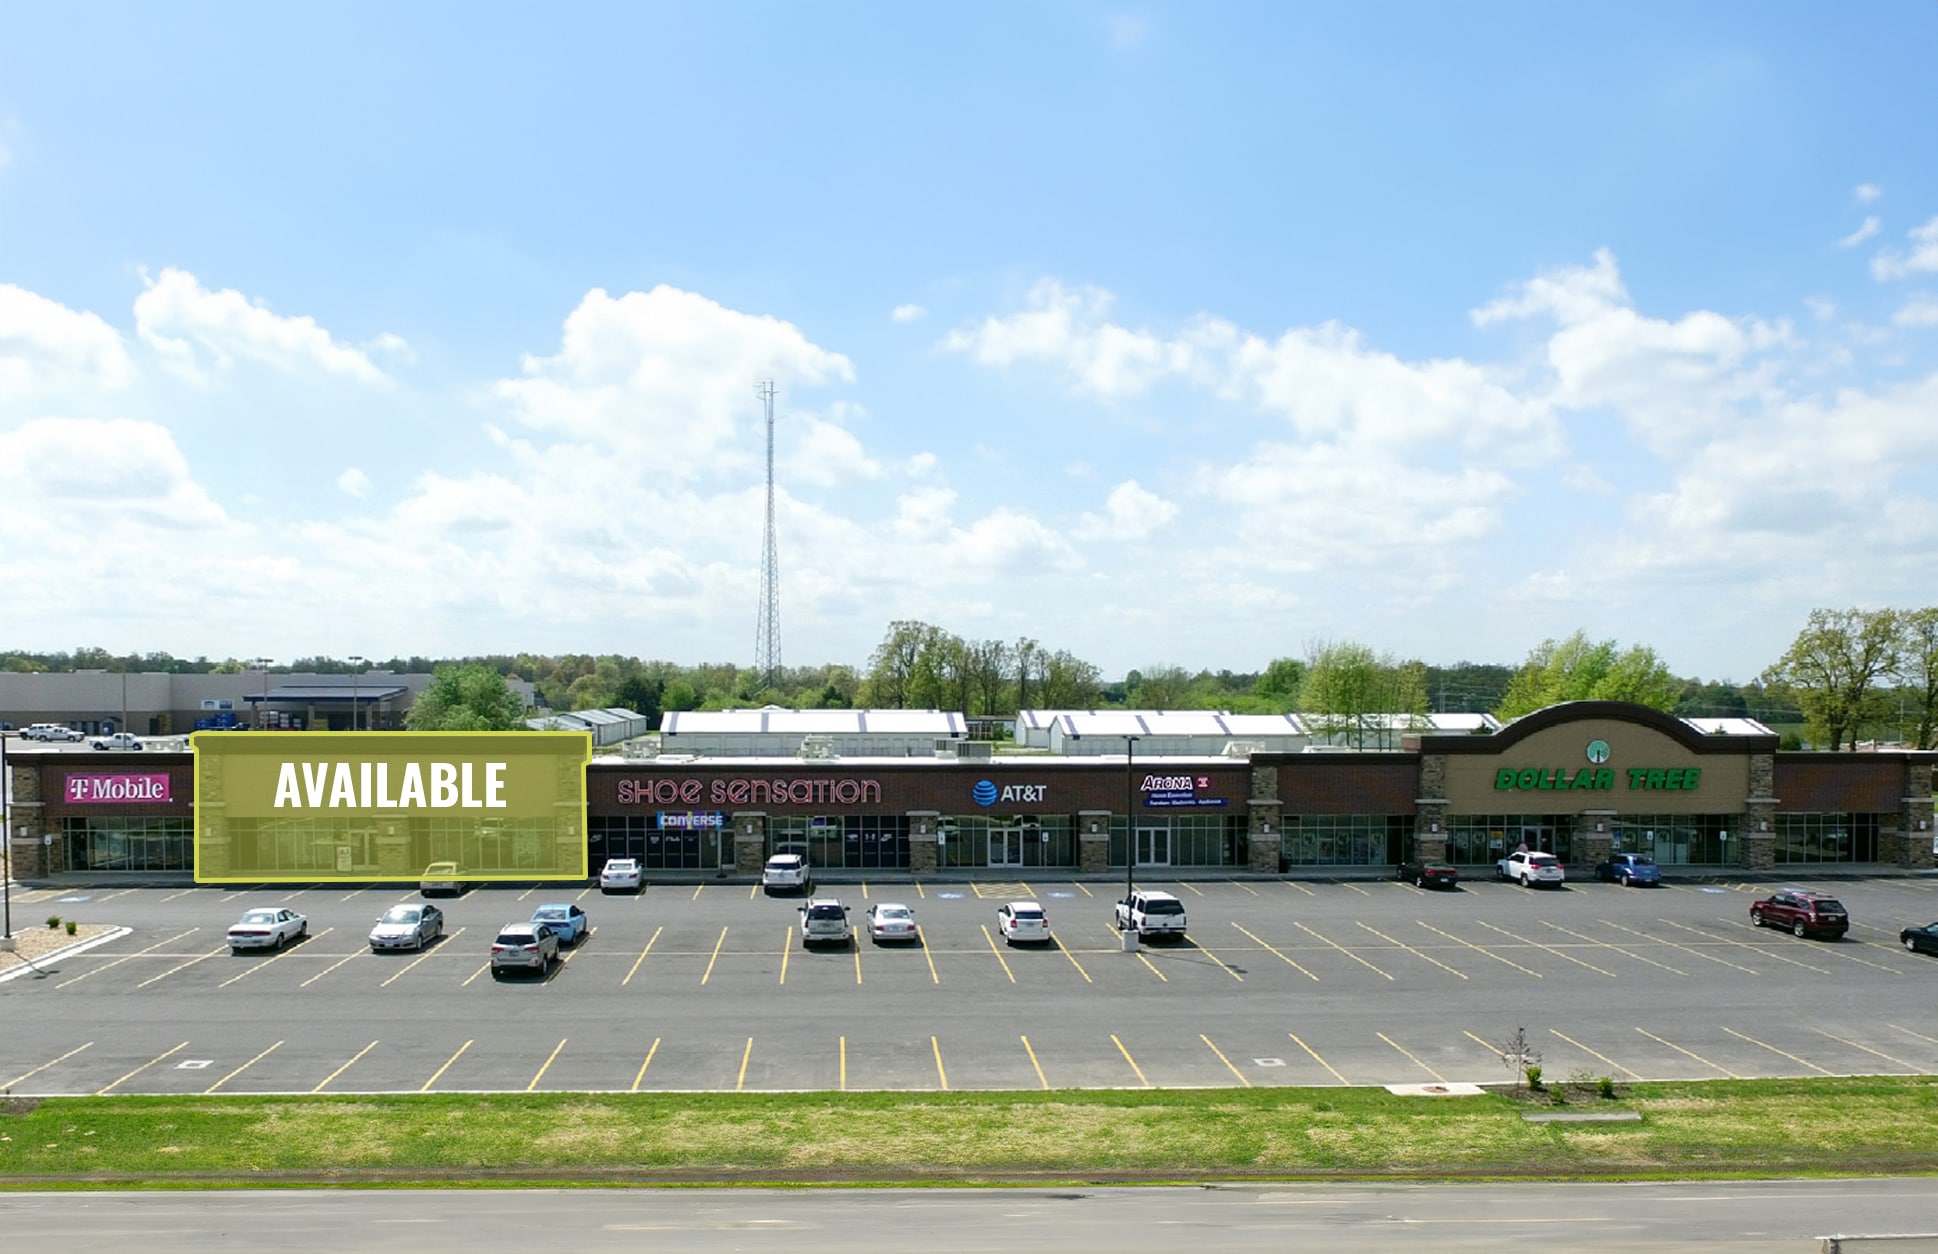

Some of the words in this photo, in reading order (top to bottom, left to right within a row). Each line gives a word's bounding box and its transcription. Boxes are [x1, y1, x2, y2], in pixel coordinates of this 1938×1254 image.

[1140, 775, 1193, 791] ARONA
[1495, 768, 1615, 790] DOLLAR
[1627, 768, 1702, 790] TREE
[1000, 785, 1047, 802] AT&T
